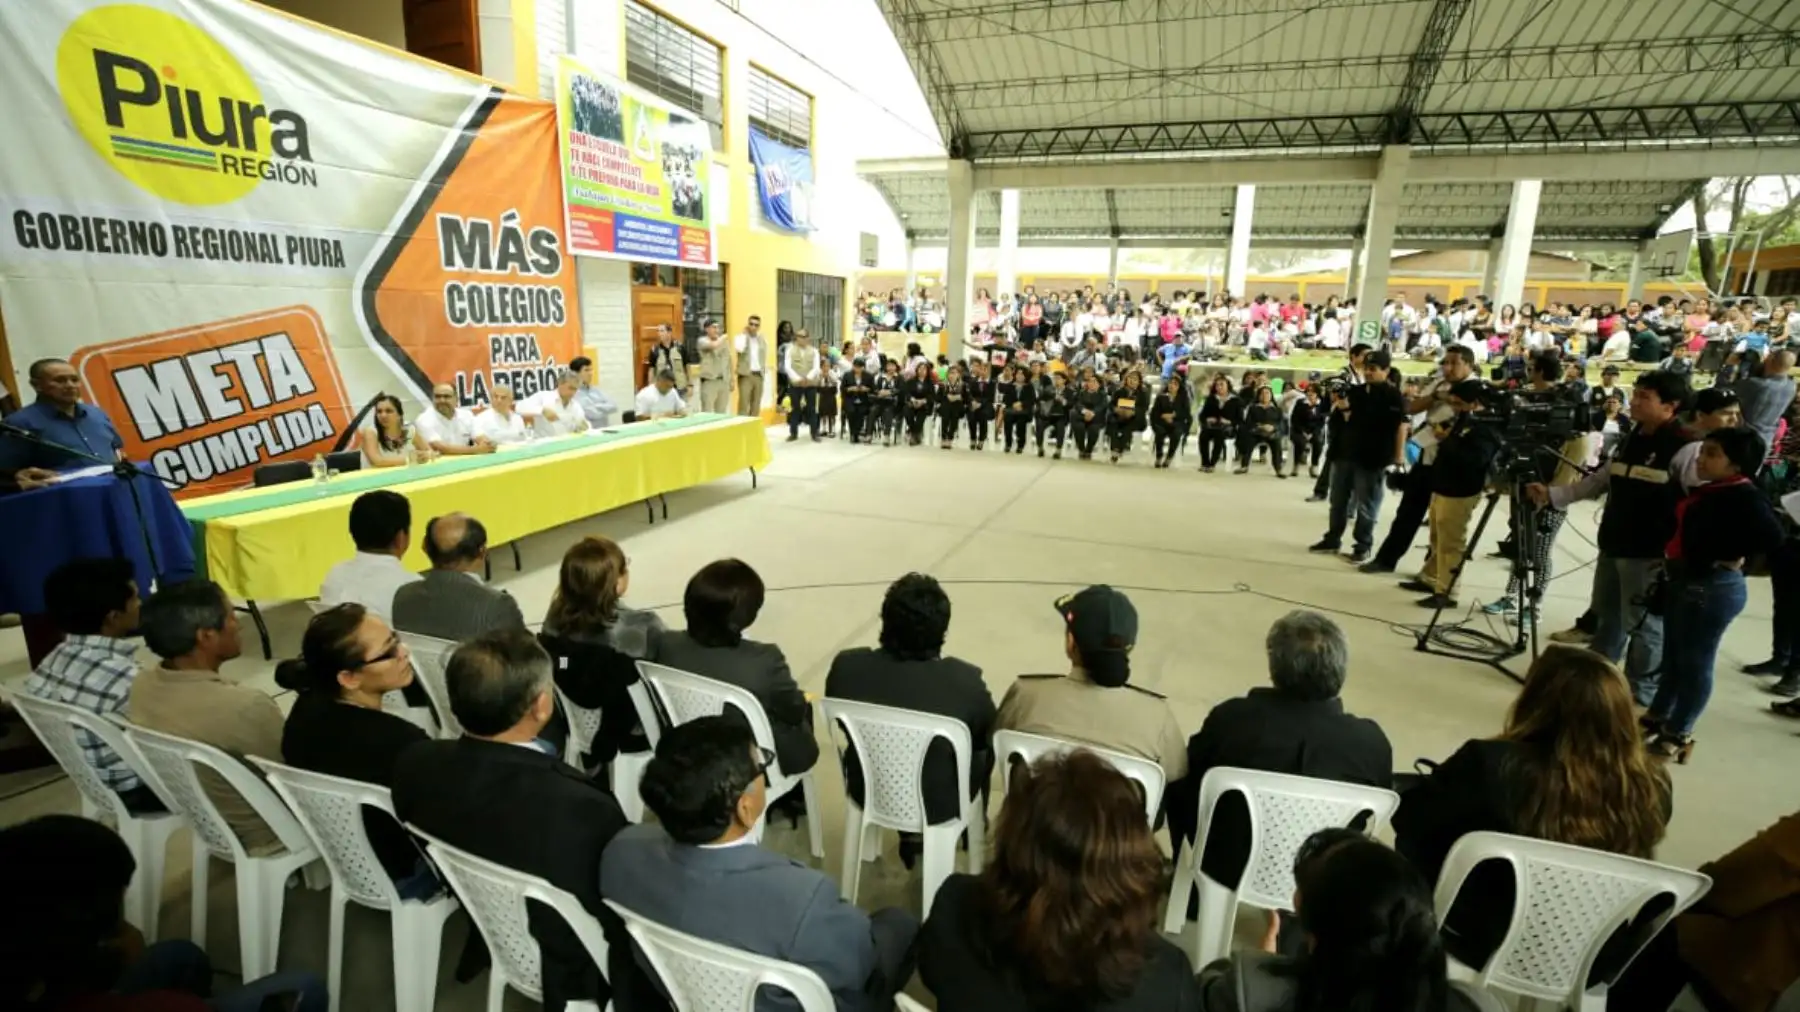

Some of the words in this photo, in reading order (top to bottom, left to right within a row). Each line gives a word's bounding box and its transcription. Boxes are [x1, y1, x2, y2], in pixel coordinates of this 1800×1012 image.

[92, 47, 314, 163] Piura
[220, 153, 318, 187] REGIÓN
[13, 210, 169, 257] GOBIERNO
[171, 224, 284, 265] REGIONAL
[285, 234, 347, 269] PIURA
[438, 210, 562, 277] MÁS
[446, 282, 566, 325] COLEGIOS
[490, 335, 541, 364] PARA
[1362, 321, 1378, 339] S
[112, 331, 317, 442] META
[457, 372, 491, 408] LA
[151, 402, 336, 490] CUMPLIDA
